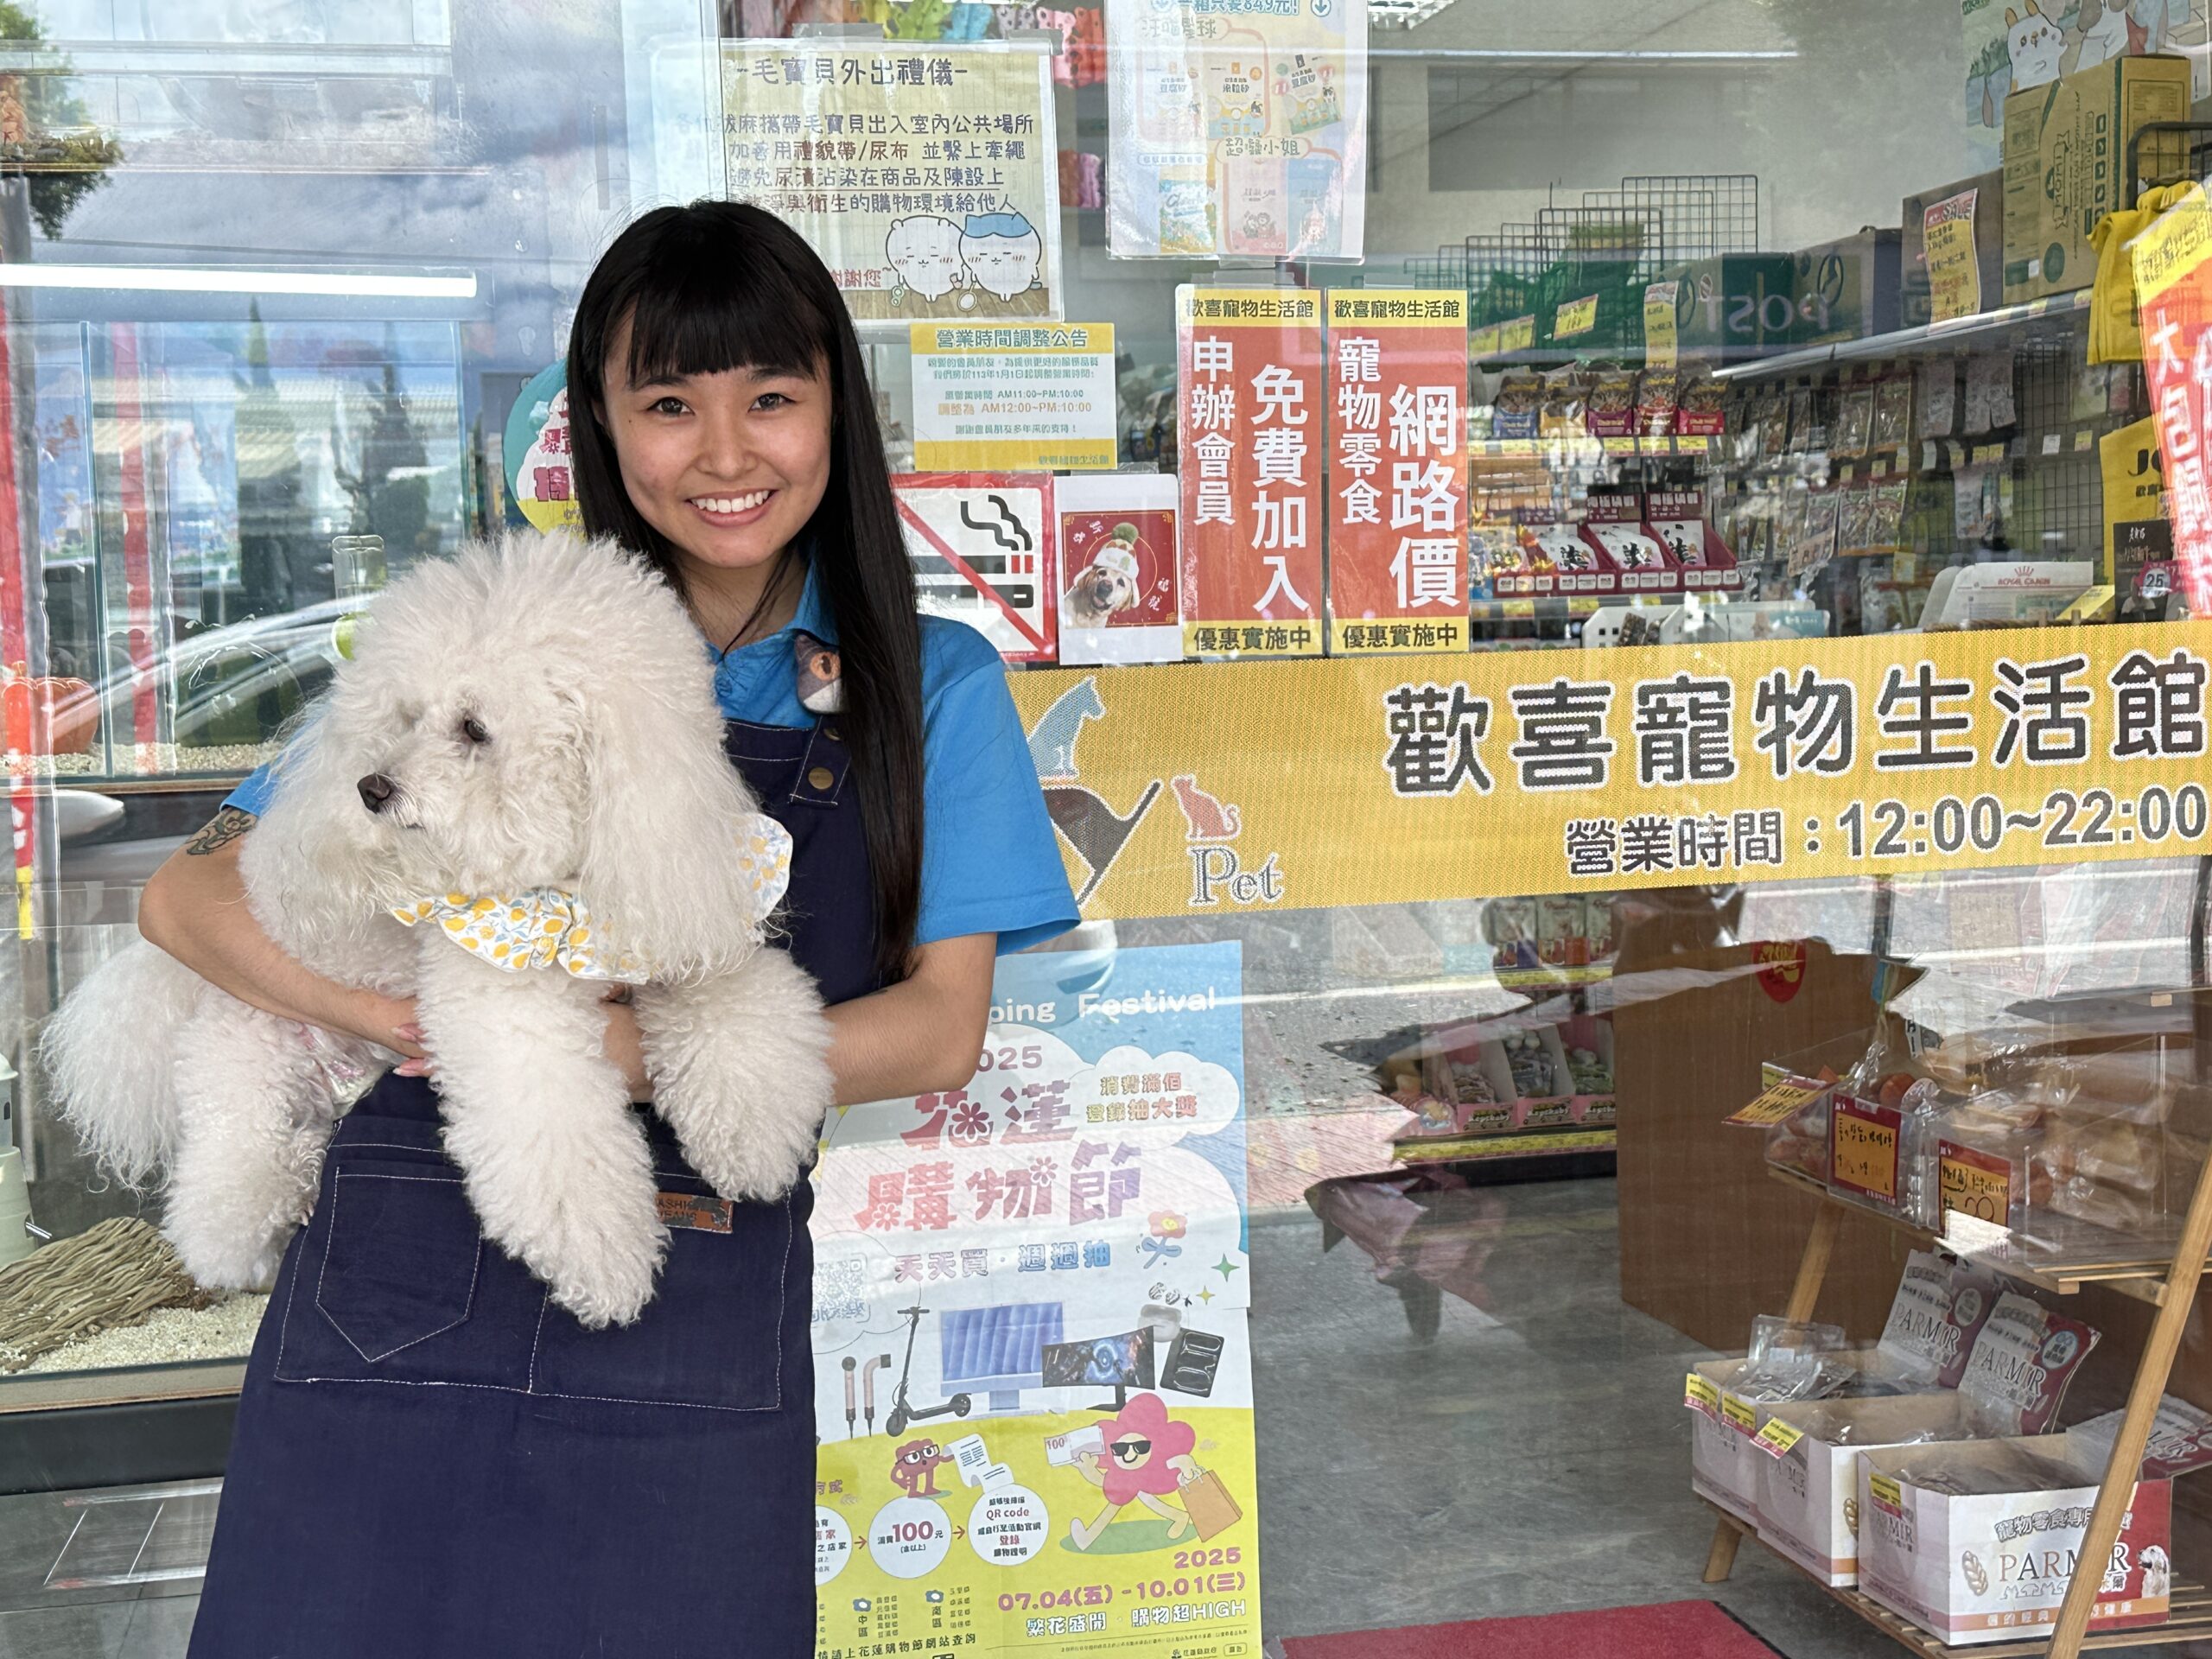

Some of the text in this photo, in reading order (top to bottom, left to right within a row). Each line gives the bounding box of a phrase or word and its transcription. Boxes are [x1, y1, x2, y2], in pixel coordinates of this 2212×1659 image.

[1186, 298, 1314, 318] 歡喜寵物生活館
[1334, 298, 1460, 319] 歡喜寵物生活館
[937, 328, 1088, 348] 營業時間調整公告
[997, 389, 1084, 399] AM11:00~PM:10:00
[981, 402, 1092, 414] AM12:00~PM:10:00
[1191, 334, 1236, 526] 申辦會員
[1338, 336, 1382, 525] 寵物零食
[1250, 364, 1310, 613] 免費加入
[1388, 384, 1461, 610] 網路價
[2145, 573, 2164, 588] 25
[1193, 626, 1312, 652] 優惠實施中
[1342, 622, 1459, 649] 優惠實施中
[1386, 652, 2206, 794] 歡喜寵物生活館
[1191, 845, 1283, 904] Pet
[988, 986, 1216, 1024] ping Festival
[977, 1046, 1043, 1072] 025
[1100, 1071, 1182, 1096] 消費滿佰
[899, 1078, 1078, 1151] 花蓮
[853, 1139, 1142, 1231] 購物節
[895, 1239, 1111, 1283] 天天買 週週抽
[1046, 1437, 1065, 1450] 100
[986, 1507, 1030, 1521] QR code
[1173, 1547, 1243, 1570] 2025
[1026, 1599, 1247, 1638] 繁花盛開 購物超HIGH
